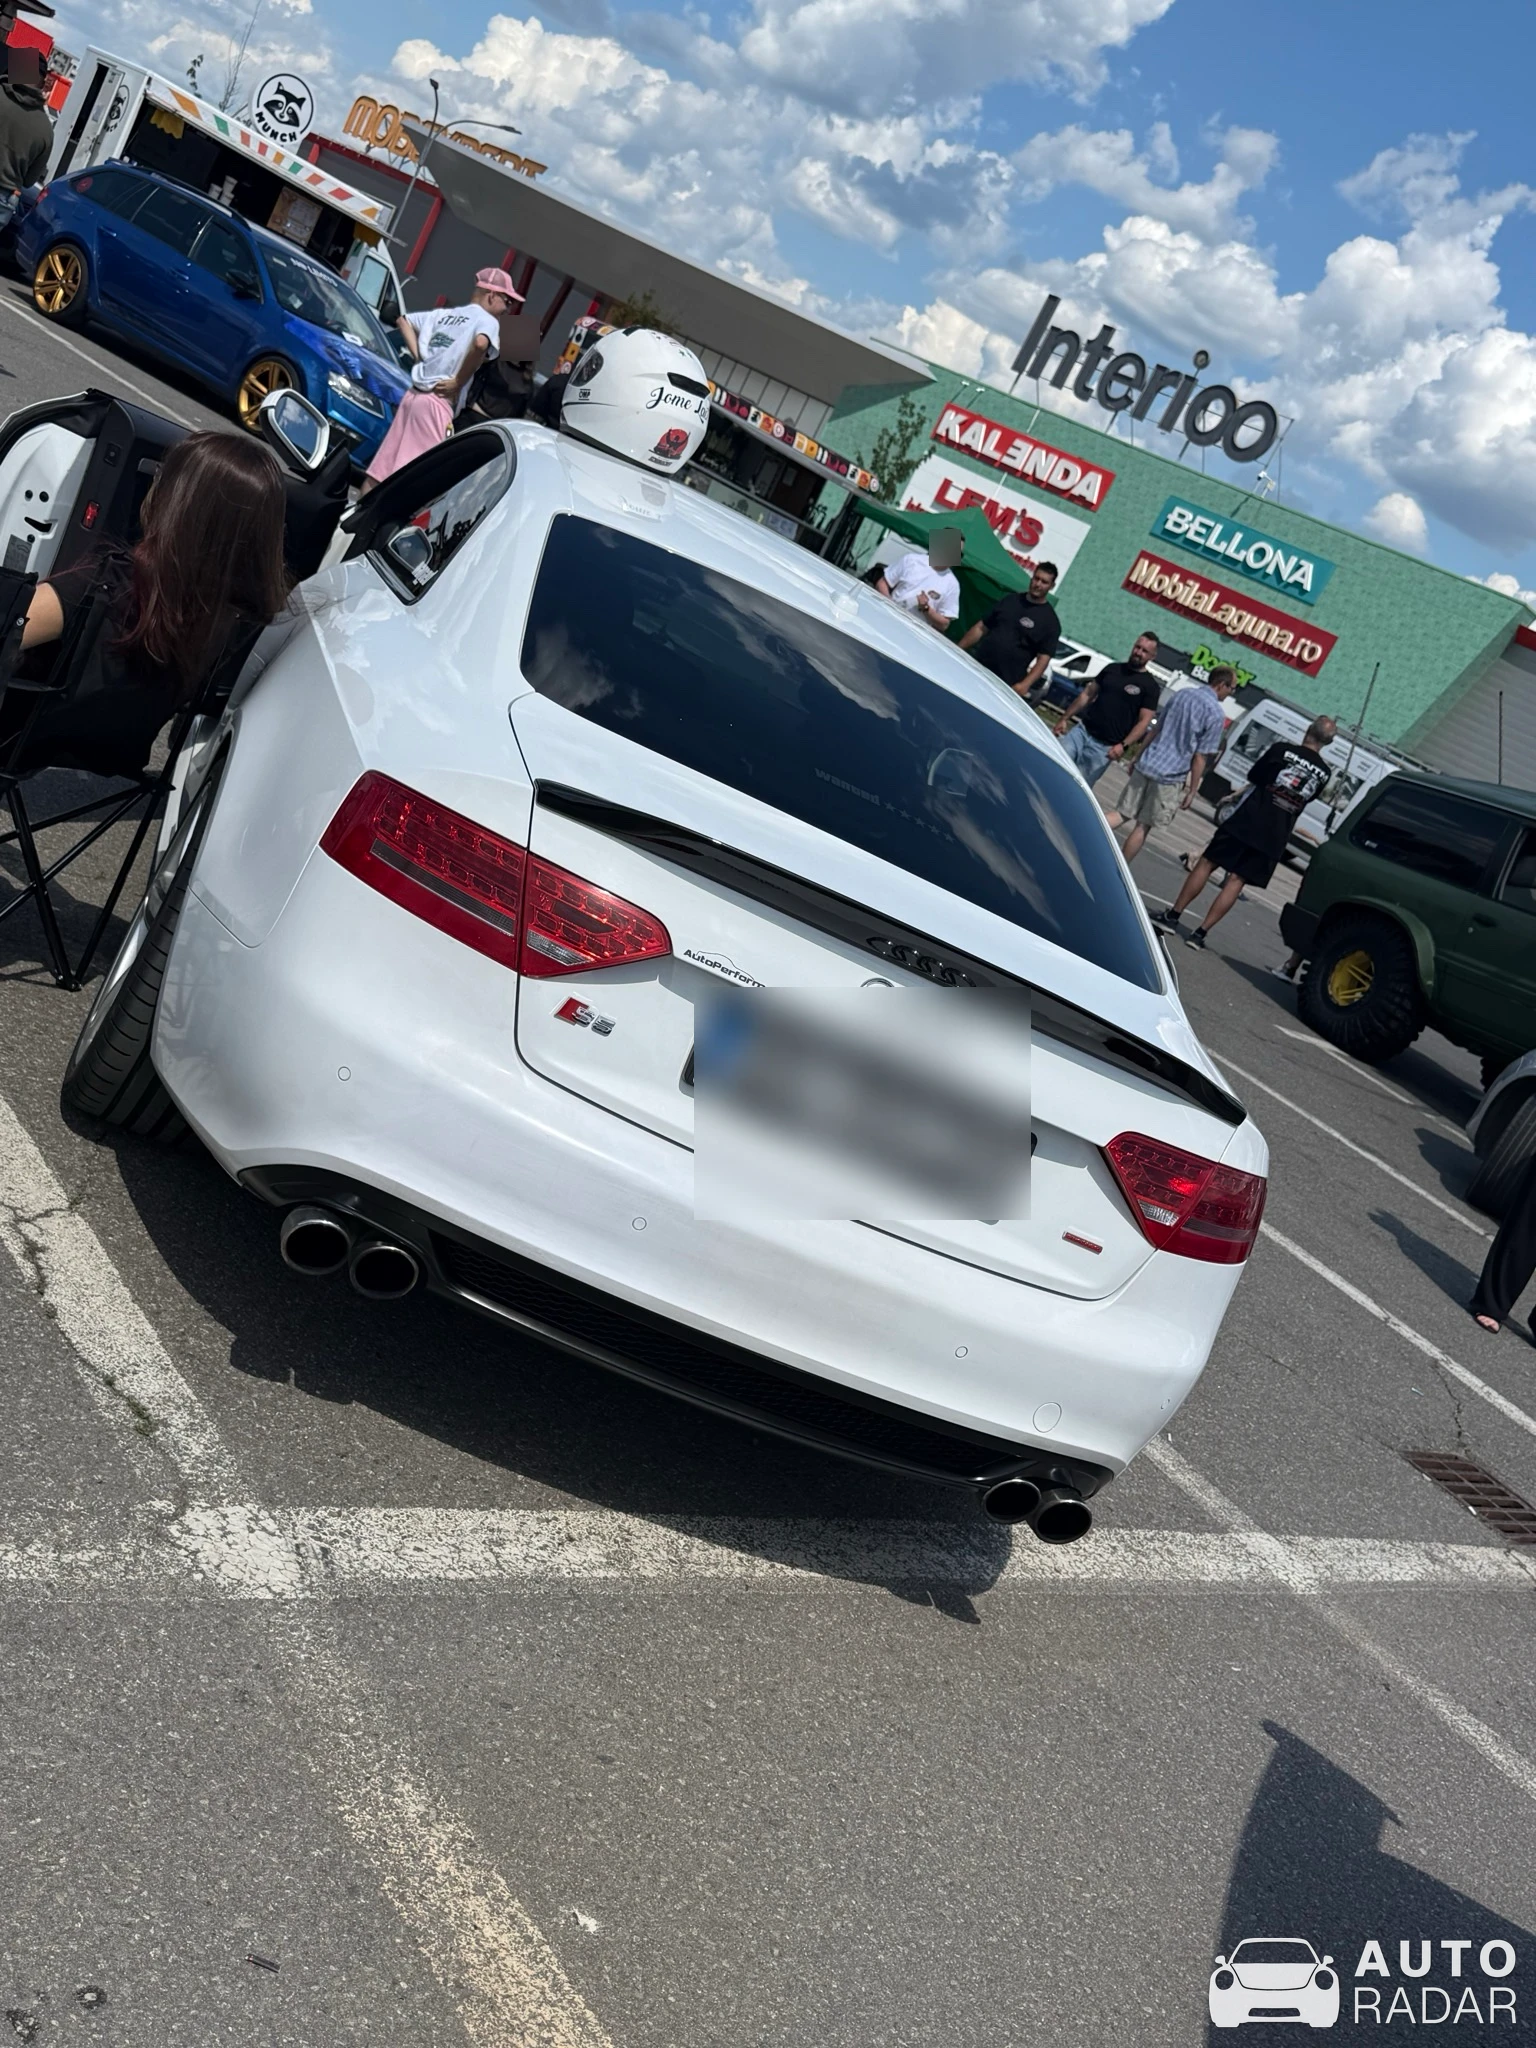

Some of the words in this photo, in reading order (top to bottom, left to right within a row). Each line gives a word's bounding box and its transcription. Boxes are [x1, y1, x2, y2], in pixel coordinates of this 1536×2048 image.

[255, 111, 298, 143] MUNCH
[438, 315, 470, 326] STAFF
[578, 390, 591, 399] OMP
[1011, 294, 1278, 463] Interioo
[646, 387, 692, 410] Jome
[1164, 506, 1314, 592] BELLONA
[1129, 557, 1322, 663] MobilaLaguna.ro
[1191, 645, 1256, 688] Door
[1284, 750, 1329, 783] PHNTM
